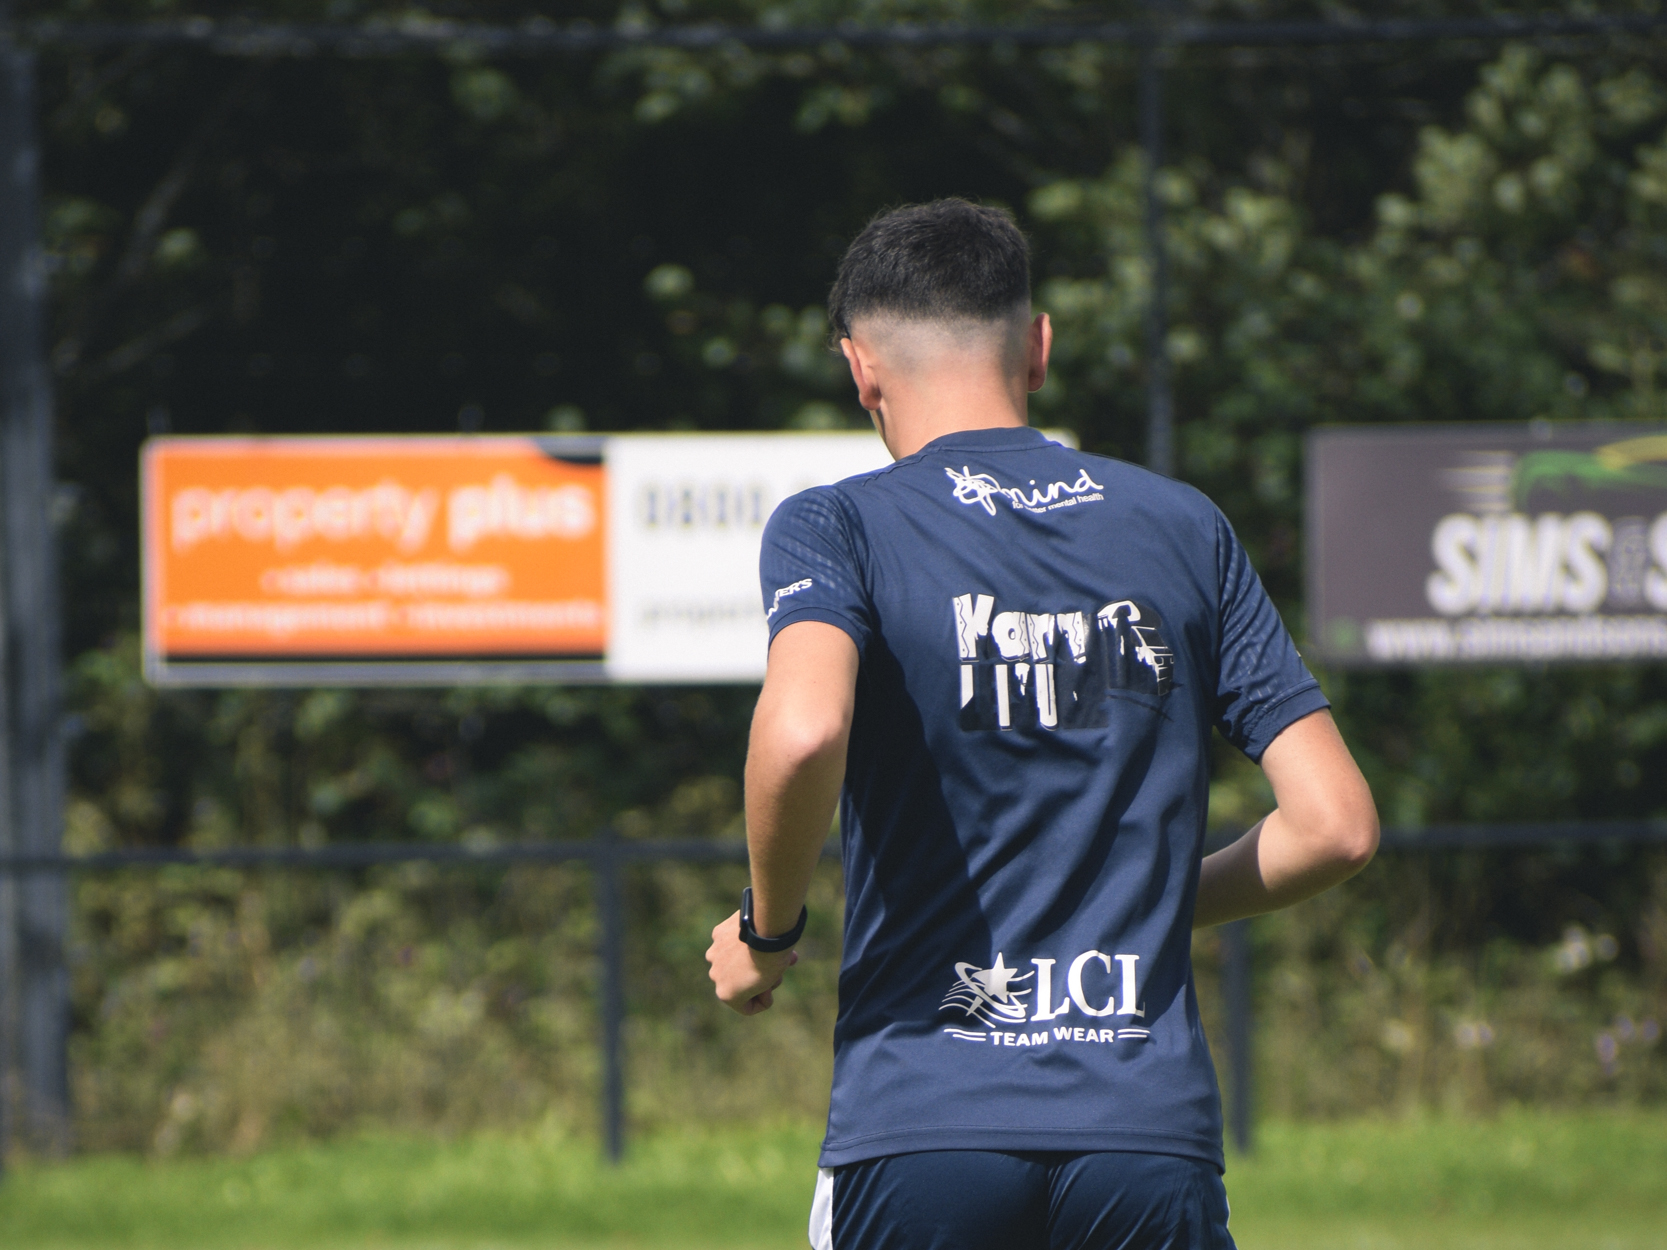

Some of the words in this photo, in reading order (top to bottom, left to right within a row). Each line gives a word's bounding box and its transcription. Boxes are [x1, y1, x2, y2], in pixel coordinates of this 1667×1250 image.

[171, 479, 438, 556] property
[448, 473, 595, 556] plus
[997, 468, 1104, 508] mind
[1048, 496, 1077, 511] mental
[1077, 492, 1104, 504] health
[1425, 510, 1615, 617] SIMS
[1030, 949, 1147, 1022] LCI
[989, 1030, 1049, 1047] TEAM
[1053, 1026, 1115, 1043] WEAR
